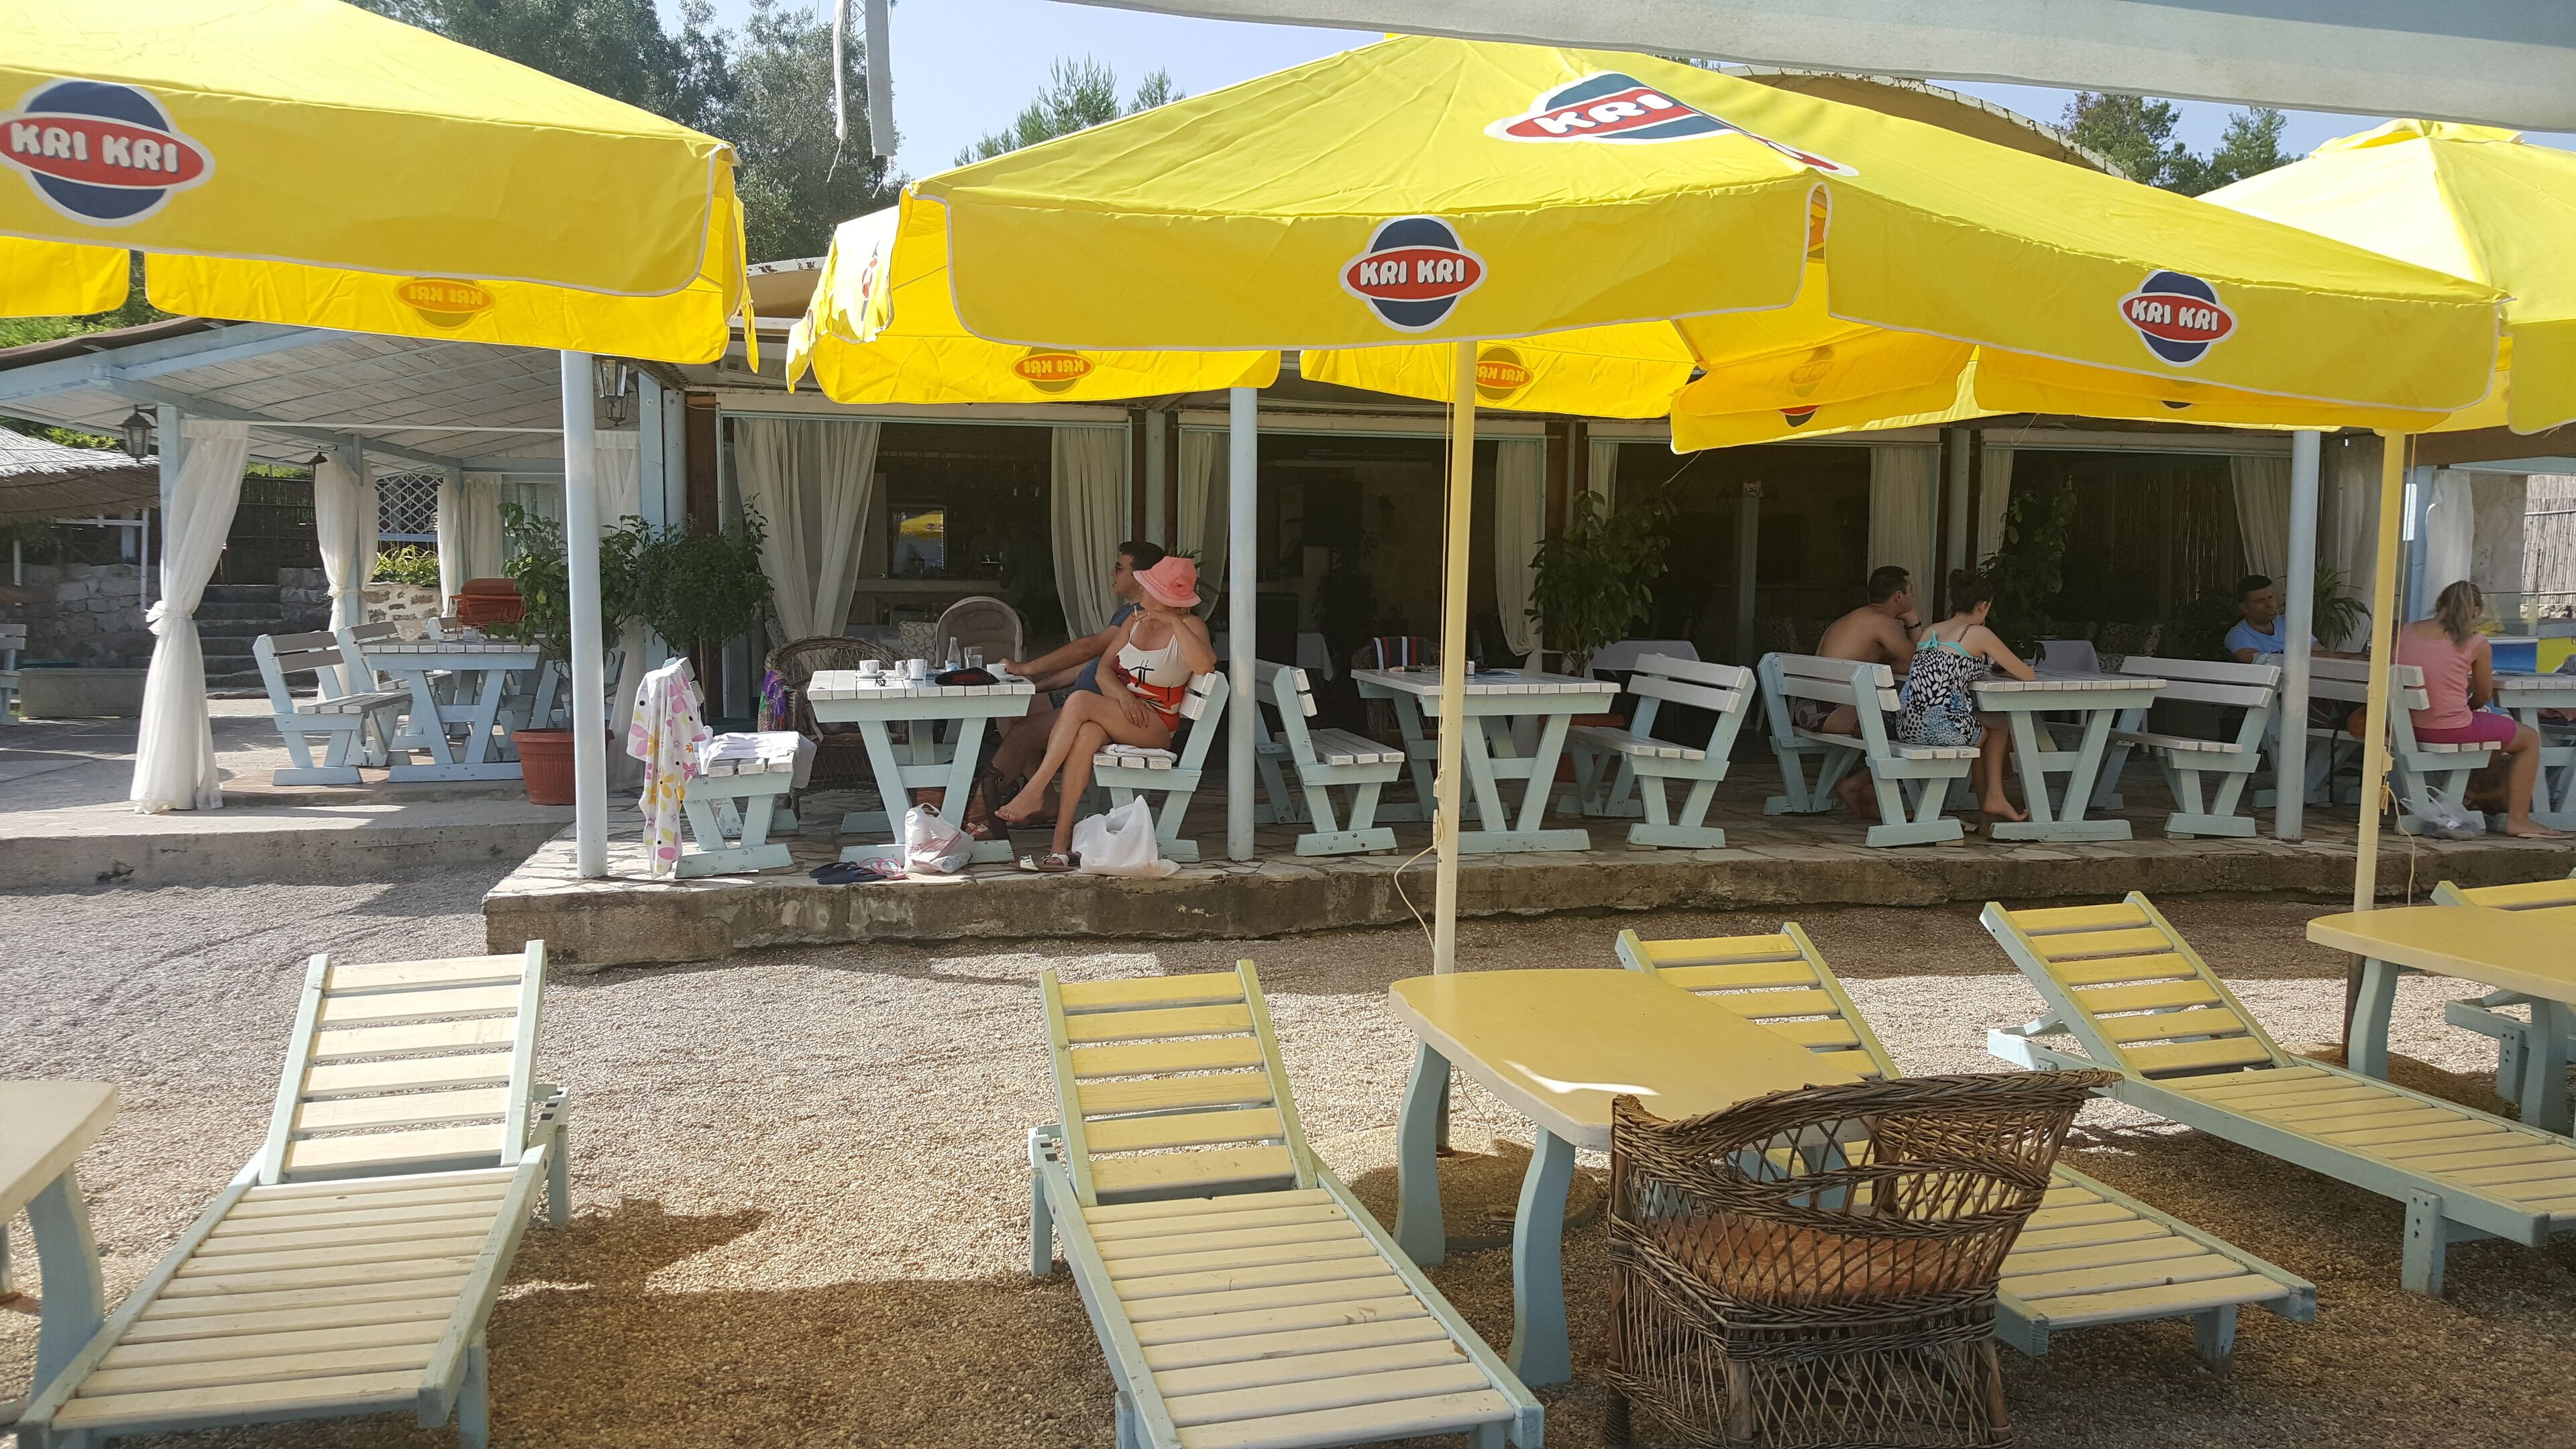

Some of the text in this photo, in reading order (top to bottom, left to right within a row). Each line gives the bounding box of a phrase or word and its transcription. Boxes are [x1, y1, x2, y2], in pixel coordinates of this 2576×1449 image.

[1534, 94, 1675, 134] KRI
[9, 121, 178, 174] KRI KRI
[1360, 258, 1465, 286] KRI KRI
[2131, 299, 2218, 331] KRI KRI
